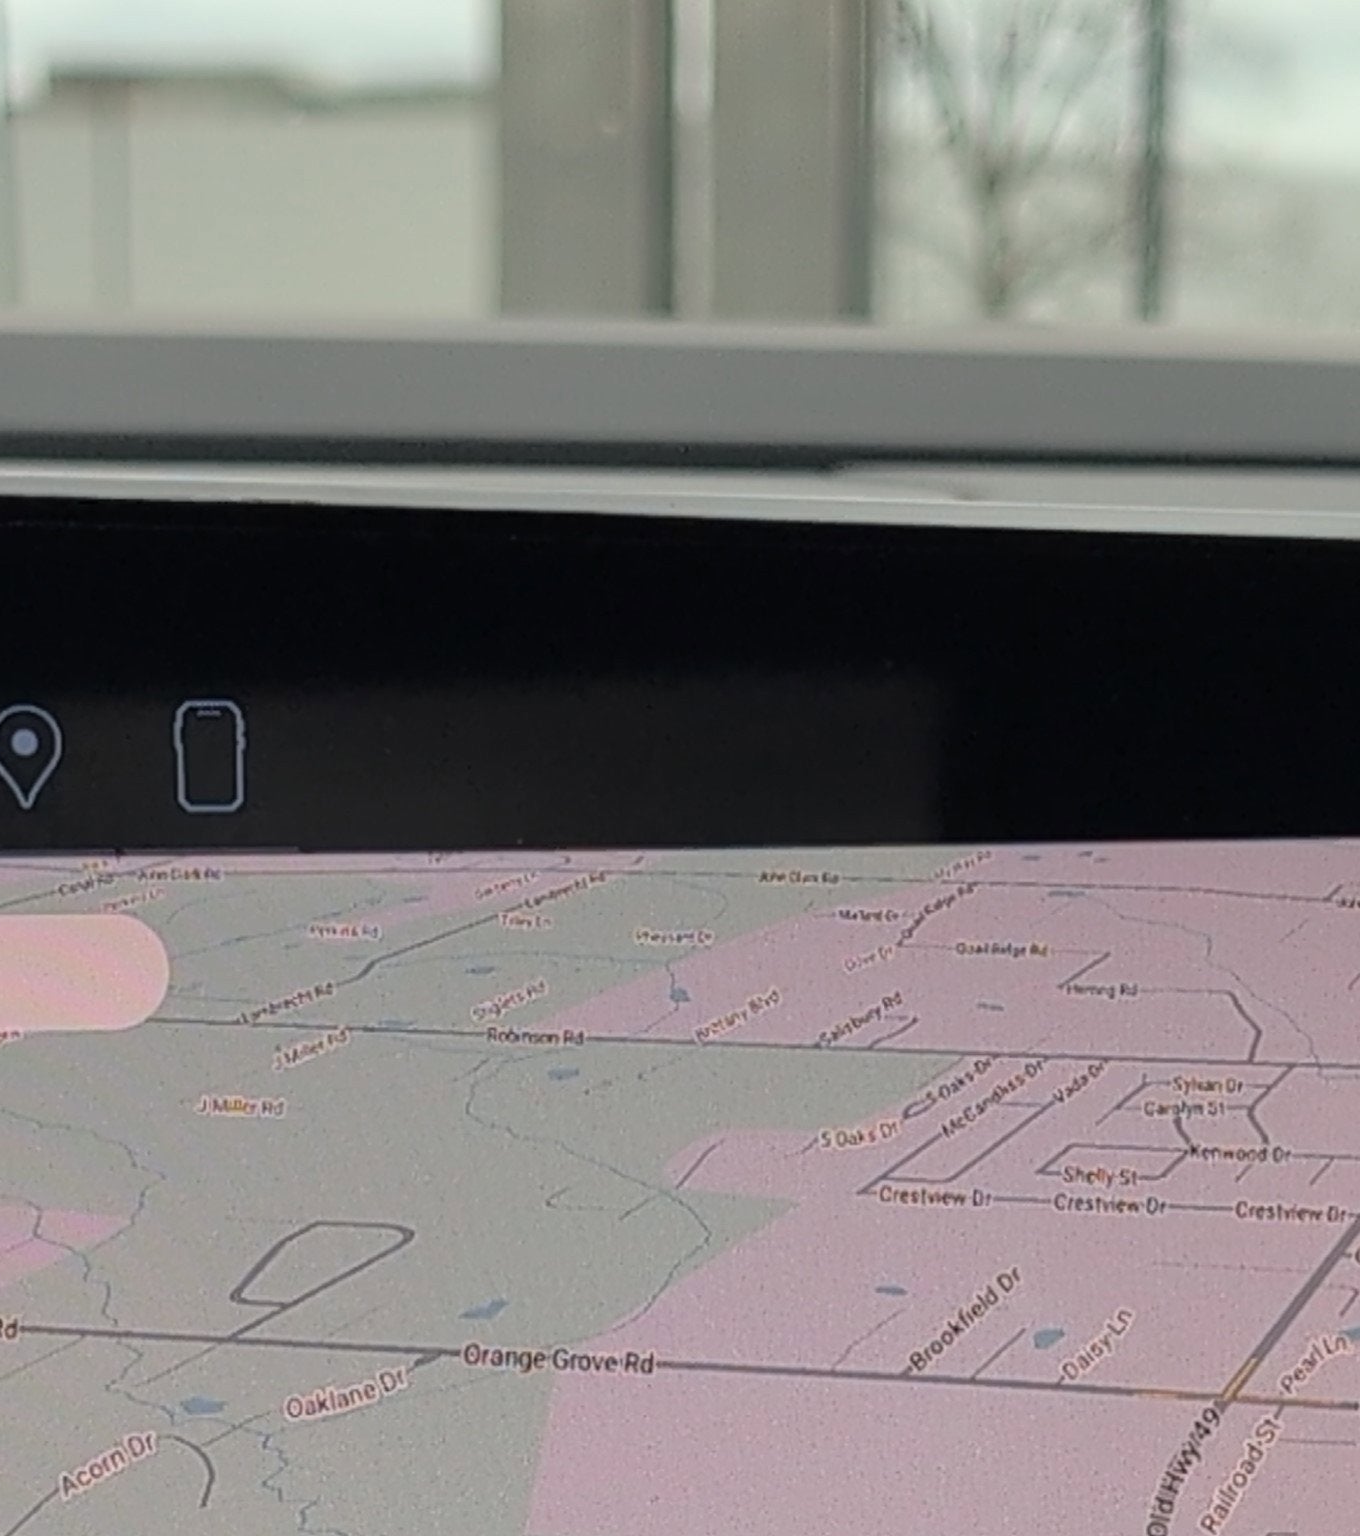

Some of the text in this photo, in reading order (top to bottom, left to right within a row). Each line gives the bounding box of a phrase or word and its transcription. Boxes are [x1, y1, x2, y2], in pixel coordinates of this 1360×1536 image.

[315, 983, 334, 998] Rd
[882, 993, 902, 1012] Rd
[327, 1029, 348, 1048] Rd
[487, 1027, 585, 1045] Robinson Rd
[1025, 1060, 1044, 1078] Dr
[1089, 1061, 1107, 1079] Dr
[938, 1075, 975, 1101] Oaks
[974, 1061, 994, 1077] Dr
[1226, 1079, 1243, 1094] Dr
[197, 1096, 285, 1115] J Miller Rd
[1144, 1100, 1227, 1119] Carolyn St
[820, 1120, 899, 1149] S Oaks Dr
[1190, 1144, 1292, 1164] Kenwood Dr
[1063, 1166, 1139, 1188] Shelly St
[879, 1186, 993, 1208] Crestview Dr
[1053, 1193, 1167, 1215] Crestview Dr
[1235, 1201, 1349, 1223] Crestview Dr
[907, 1265, 1024, 1375] Brookfield Dr
[1060, 1309, 1134, 1381] Daisy Ln
[462, 1344, 655, 1374] Orange Grove Rd
[1281, 1336, 1349, 1393] Pearl Ln
[285, 1368, 408, 1420] Oaklane Dr
[1161, 1438, 1208, 1496] Hwy
[1192, 1406, 1223, 1444] 49
[59, 1431, 158, 1497] Acorn Dr
[1200, 1416, 1284, 1536] Railroad St
